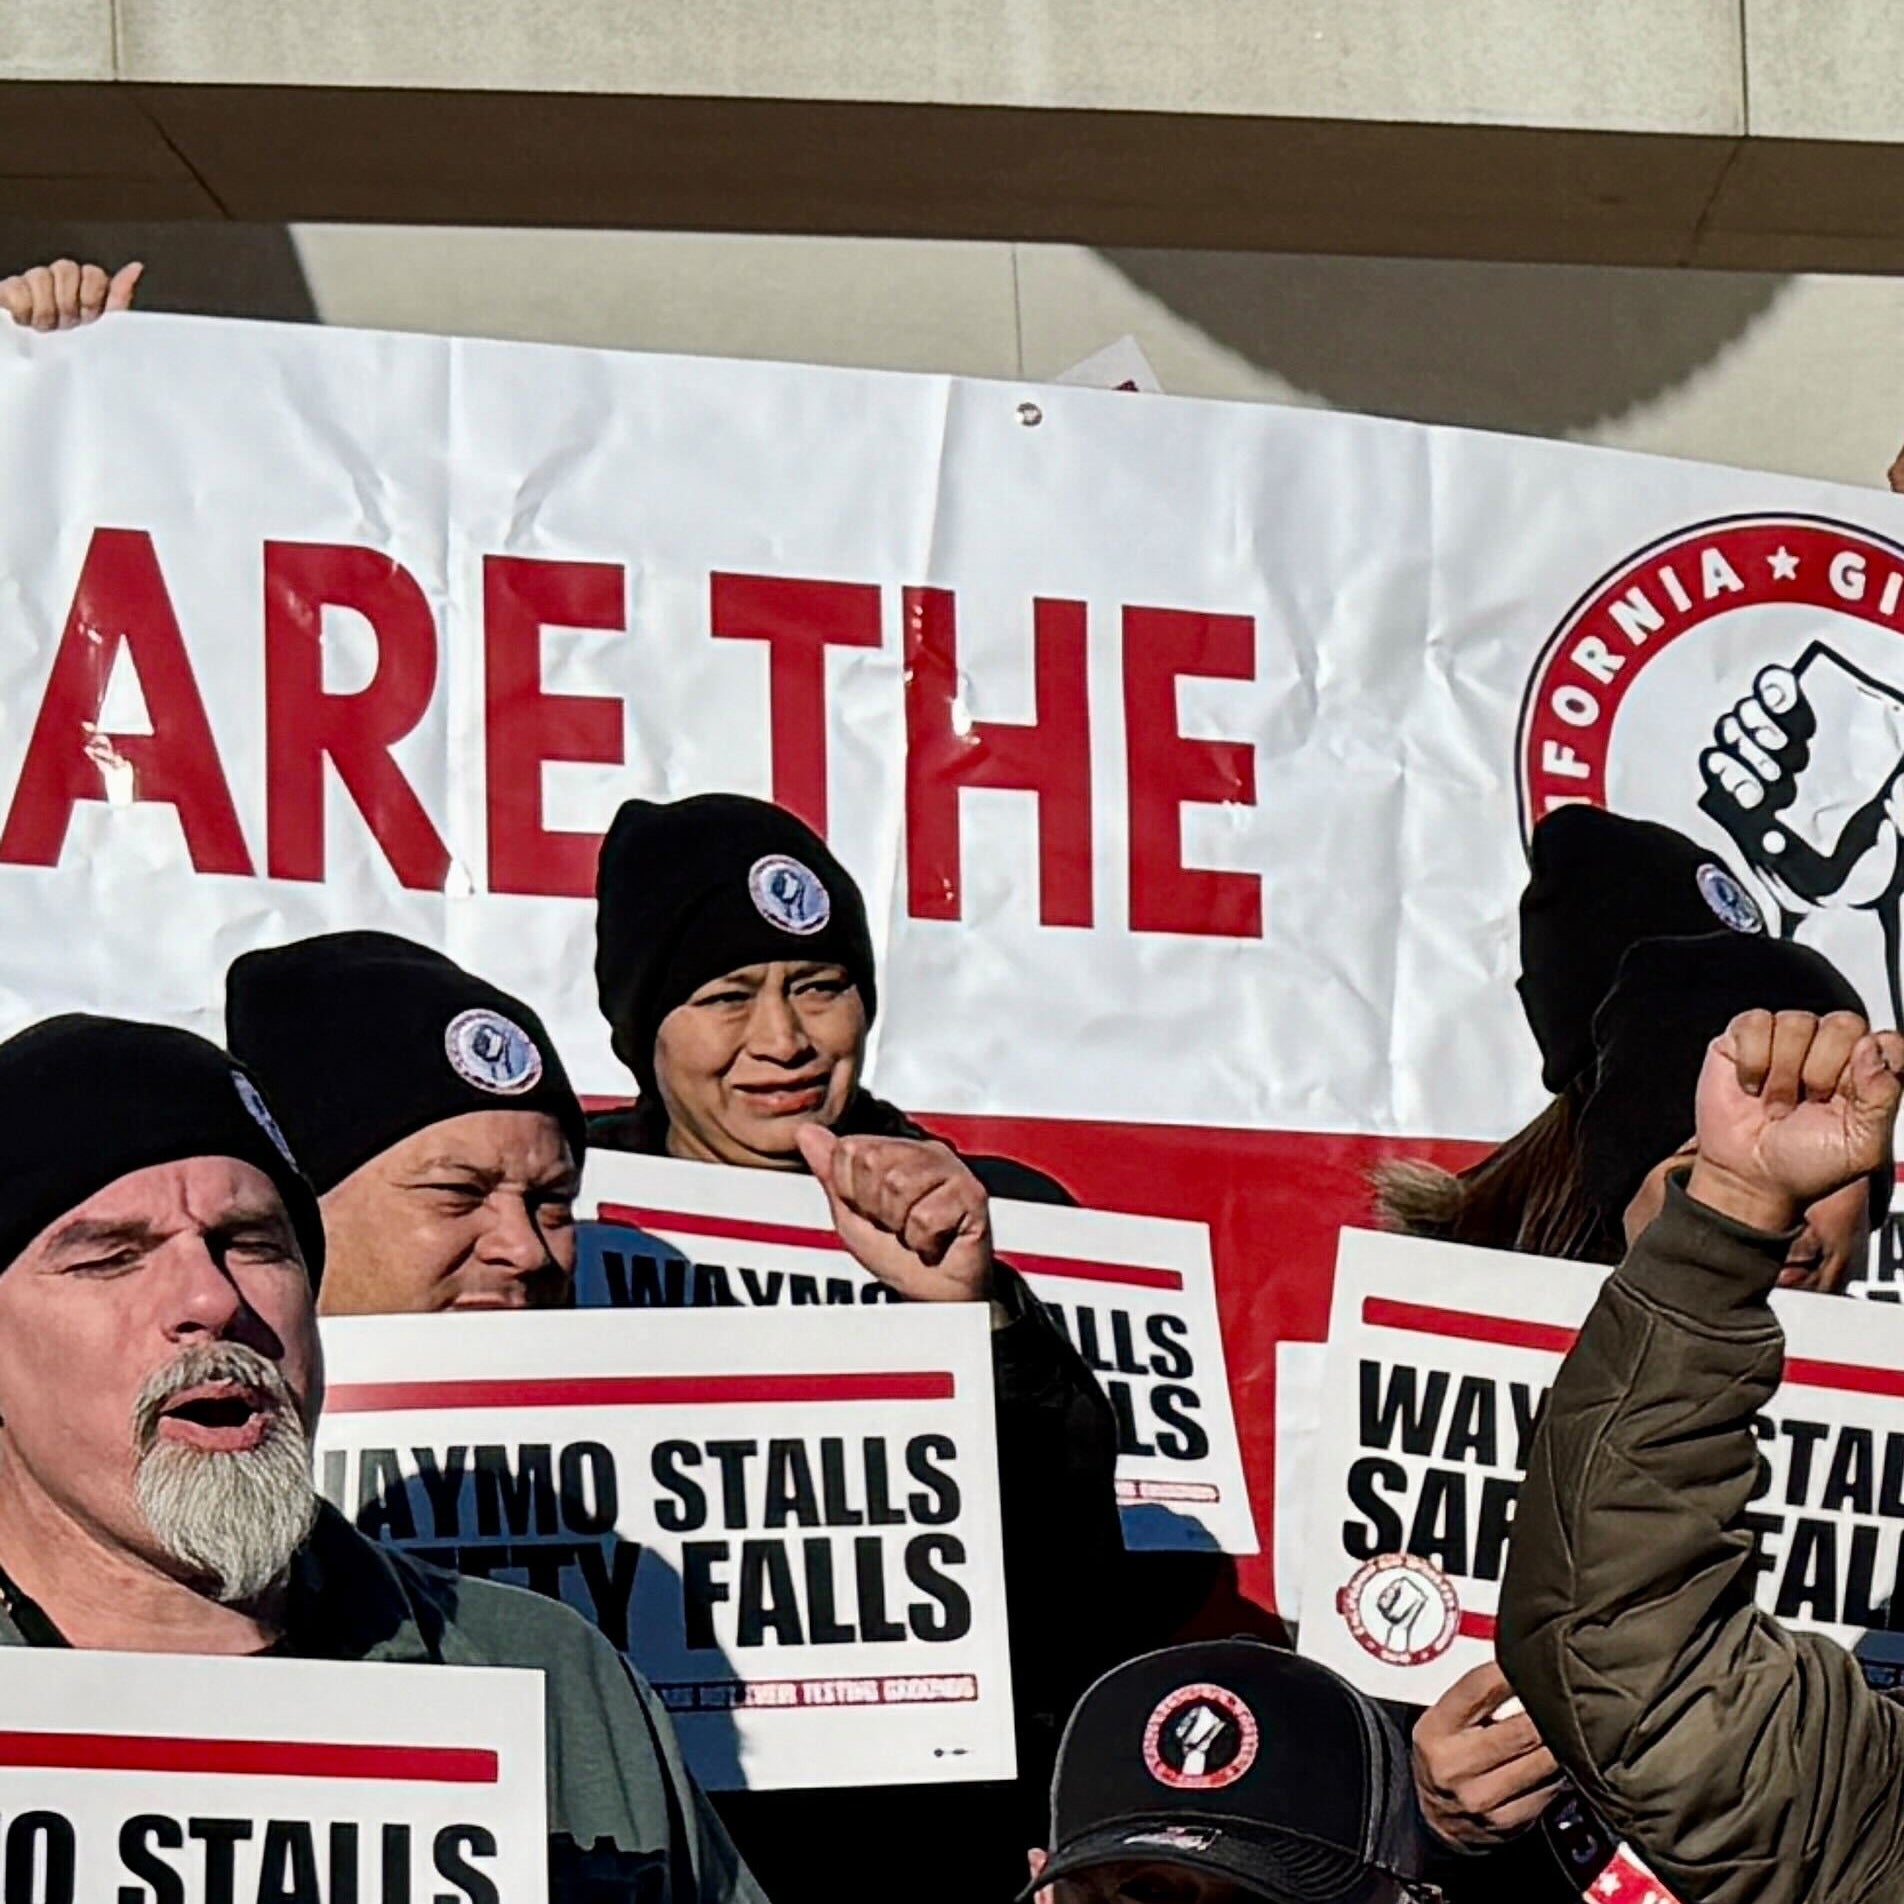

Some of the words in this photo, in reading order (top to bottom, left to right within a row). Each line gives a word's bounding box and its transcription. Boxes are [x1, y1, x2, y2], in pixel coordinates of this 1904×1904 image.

[0, 527, 626, 897] ARE
[711, 569, 1263, 939] THE
[1360, 1359, 1553, 1470] WAY
[650, 1434, 963, 1532] STALLS
[1343, 1457, 1519, 1582] SAF
[683, 1535, 972, 1648] FALLS
